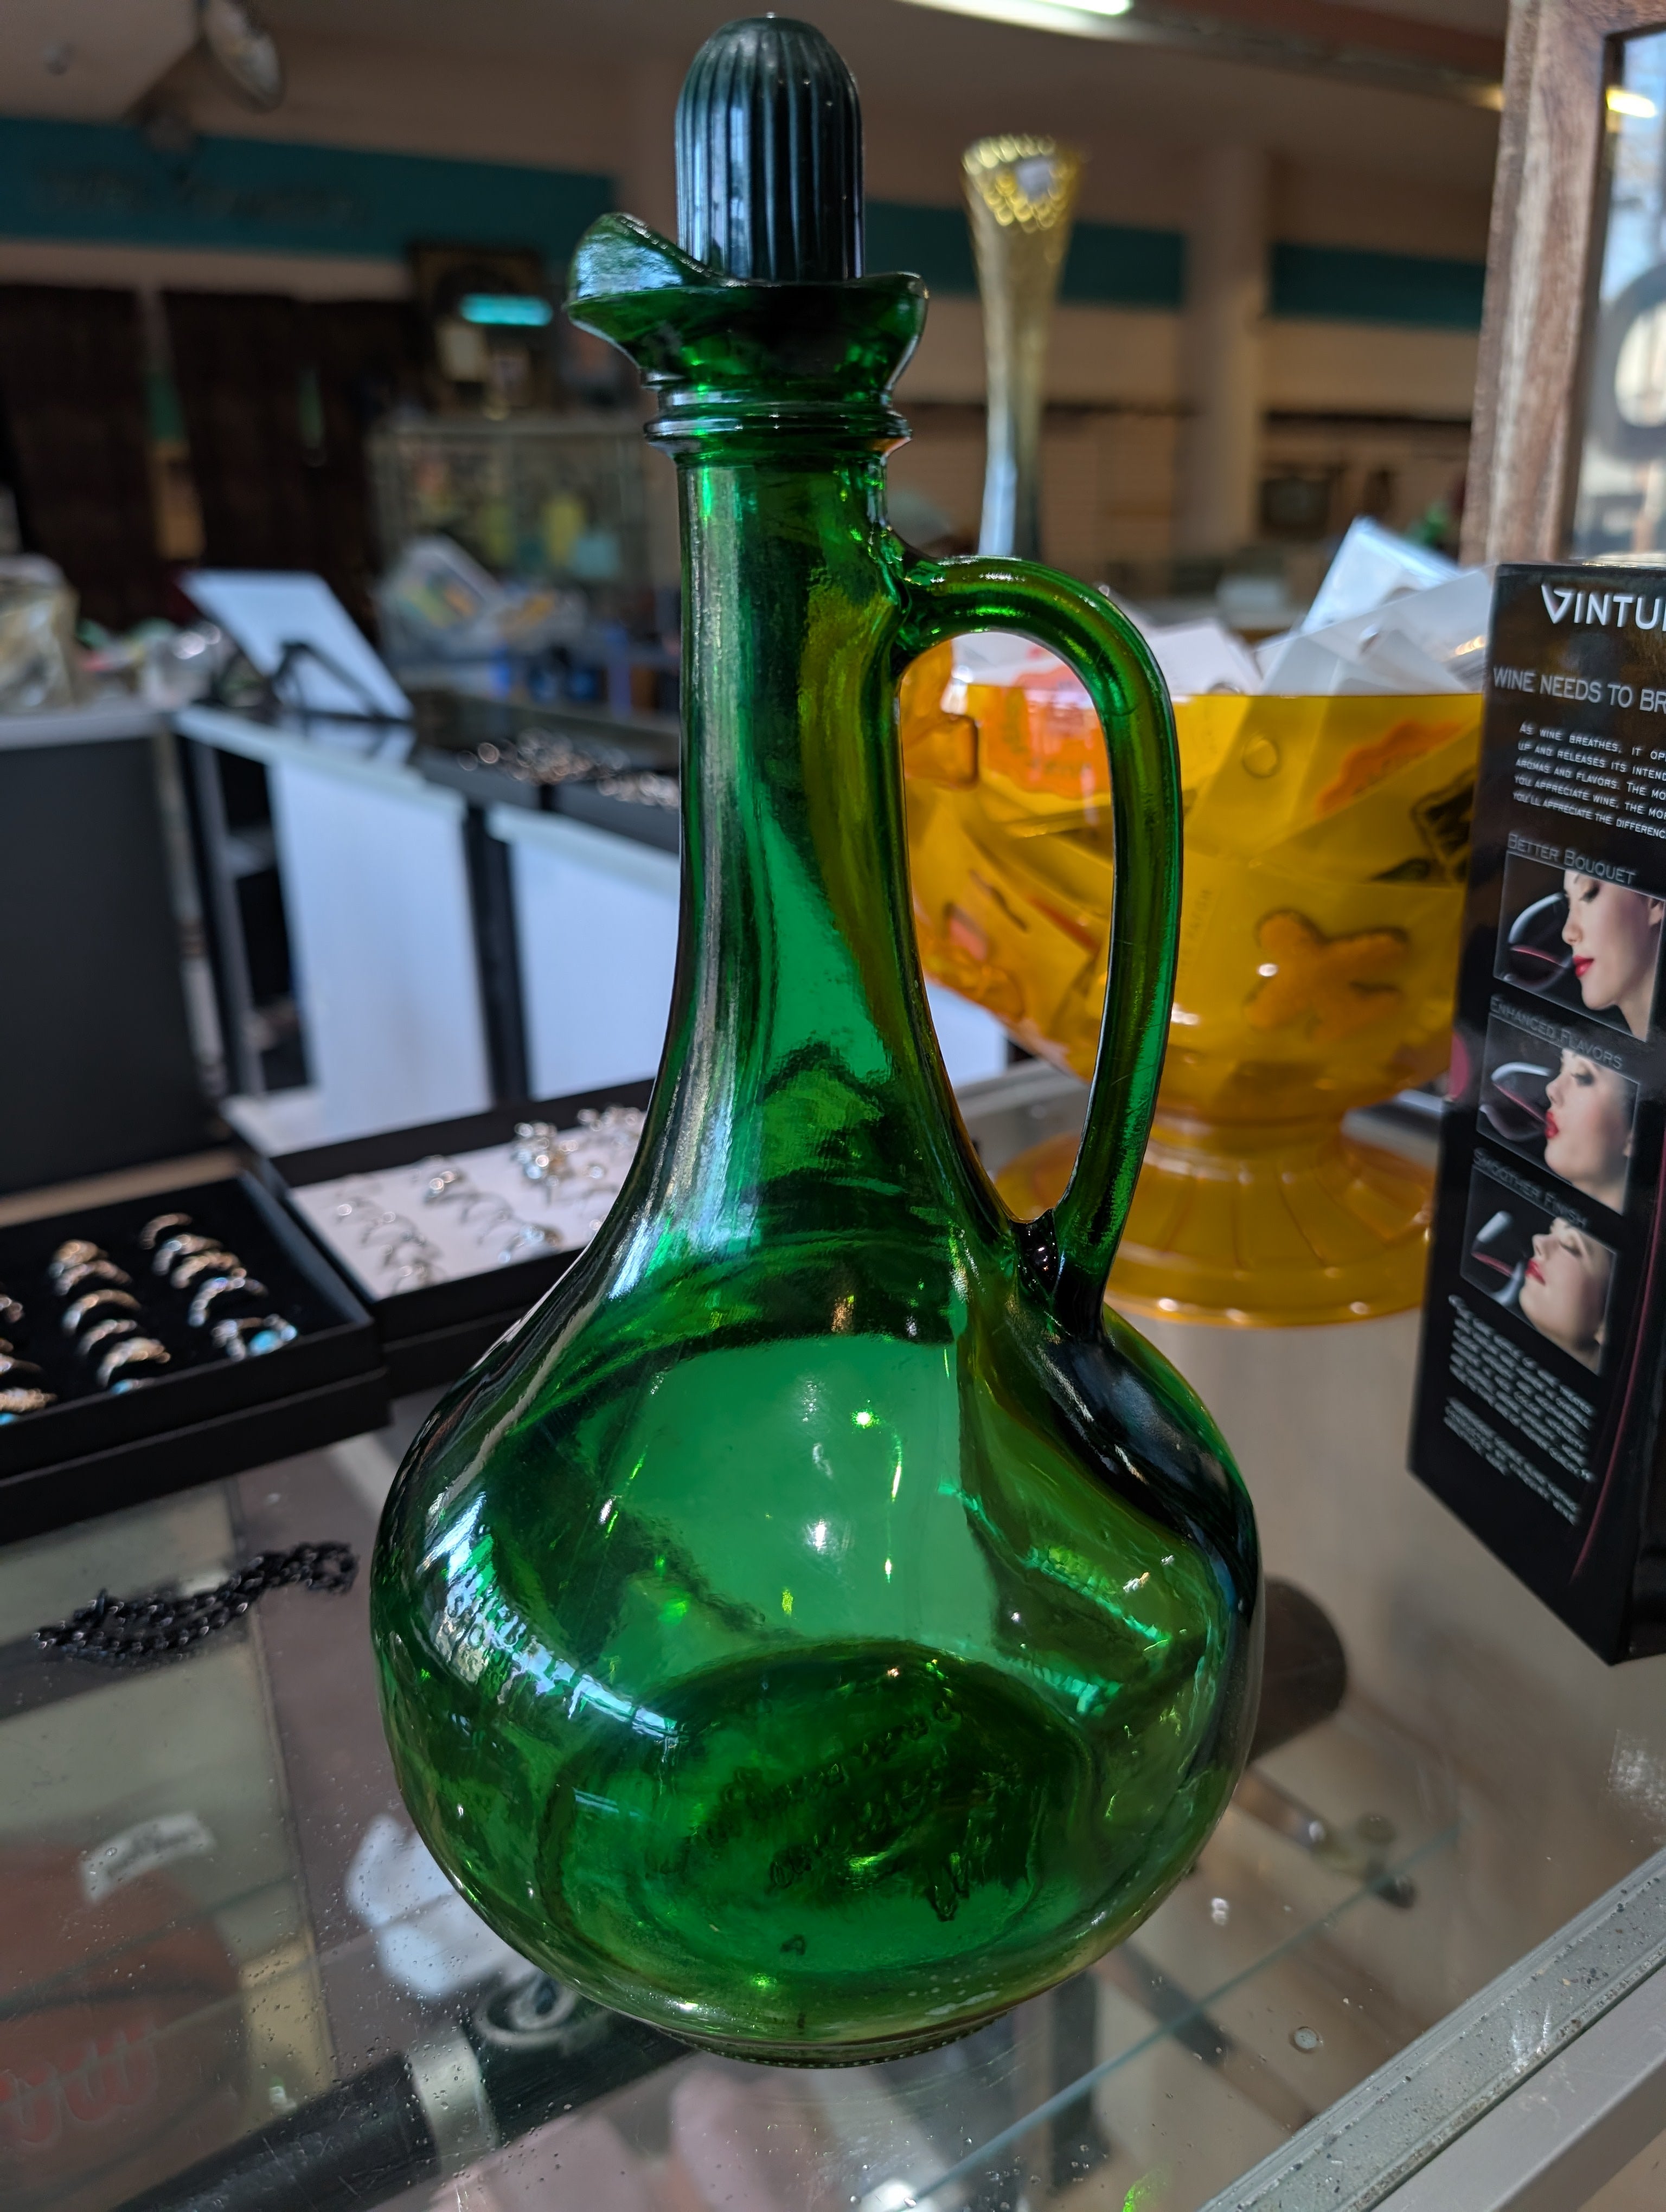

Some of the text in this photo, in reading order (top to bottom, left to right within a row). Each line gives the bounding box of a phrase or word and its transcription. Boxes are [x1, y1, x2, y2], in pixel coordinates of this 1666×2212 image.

[1541, 584, 1666, 632] VINTU
[1493, 666, 1536, 693] WINE
[1540, 674, 1601, 704] NEEDS
[1607, 683, 1633, 709] TO
[1518, 741, 1533, 751] UP
[1534, 745, 1554, 756] AND
[1557, 750, 1606, 768] RELEASES
[1611, 761, 1627, 773] ITS
[1520, 724, 1534, 735] AS
[1539, 729, 1562, 741] WINE
[1631, 747, 1643, 756] IT
[1650, 750, 1666, 762] OP
[1514, 775, 1532, 787] YOU
[1534, 781, 1592, 801] APPRECIATE
[1625, 802, 1646, 814] THE
[1516, 759, 1552, 774] AROMAS
[1554, 766, 1573, 779] AND
[1626, 782, 1647, 796] THE
[1543, 799, 1594, 820] APPRECIATE
[1595, 813, 1614, 826] THE
[1616, 818, 1666, 840] DIFFERENC
[1507, 833, 1636, 885] BETTER BOUQUET
